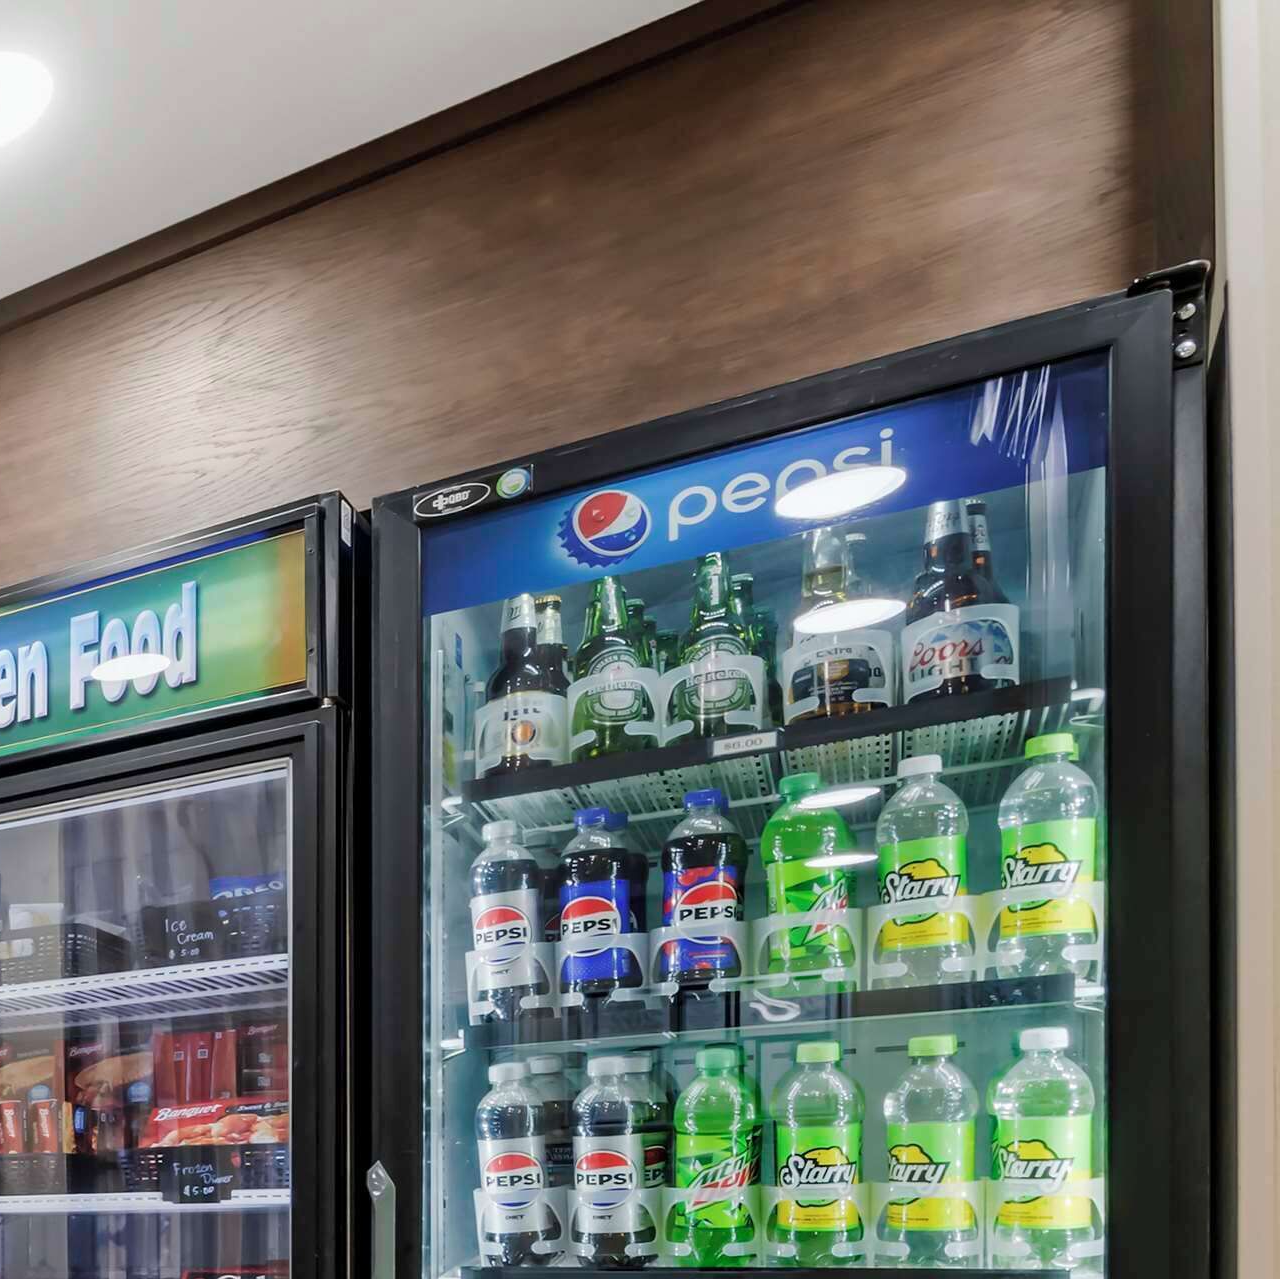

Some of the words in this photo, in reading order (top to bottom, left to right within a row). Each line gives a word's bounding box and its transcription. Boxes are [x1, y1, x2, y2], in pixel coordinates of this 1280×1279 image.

[69, 580, 198, 710] Food
[909, 636, 986, 673] Coors
[723, 738, 763, 751] $6.00
[1001, 857, 1082, 894] Starry
[884, 873, 959, 910] Starry
[679, 904, 738, 921] PEPSI
[164, 918, 187, 933] Ice
[562, 917, 617, 936] PEPSI
[177, 931, 214, 945] Cream
[475, 927, 528, 944] PEPSI
[153, 1103, 224, 1122] Banquet
[172, 1162, 213, 1176] Frozen
[787, 1157, 857, 1192] Starry
[889, 1158, 946, 1194] tarry
[486, 1172, 541, 1188] PEPSI
[576, 1172, 633, 1188] PEPSI
